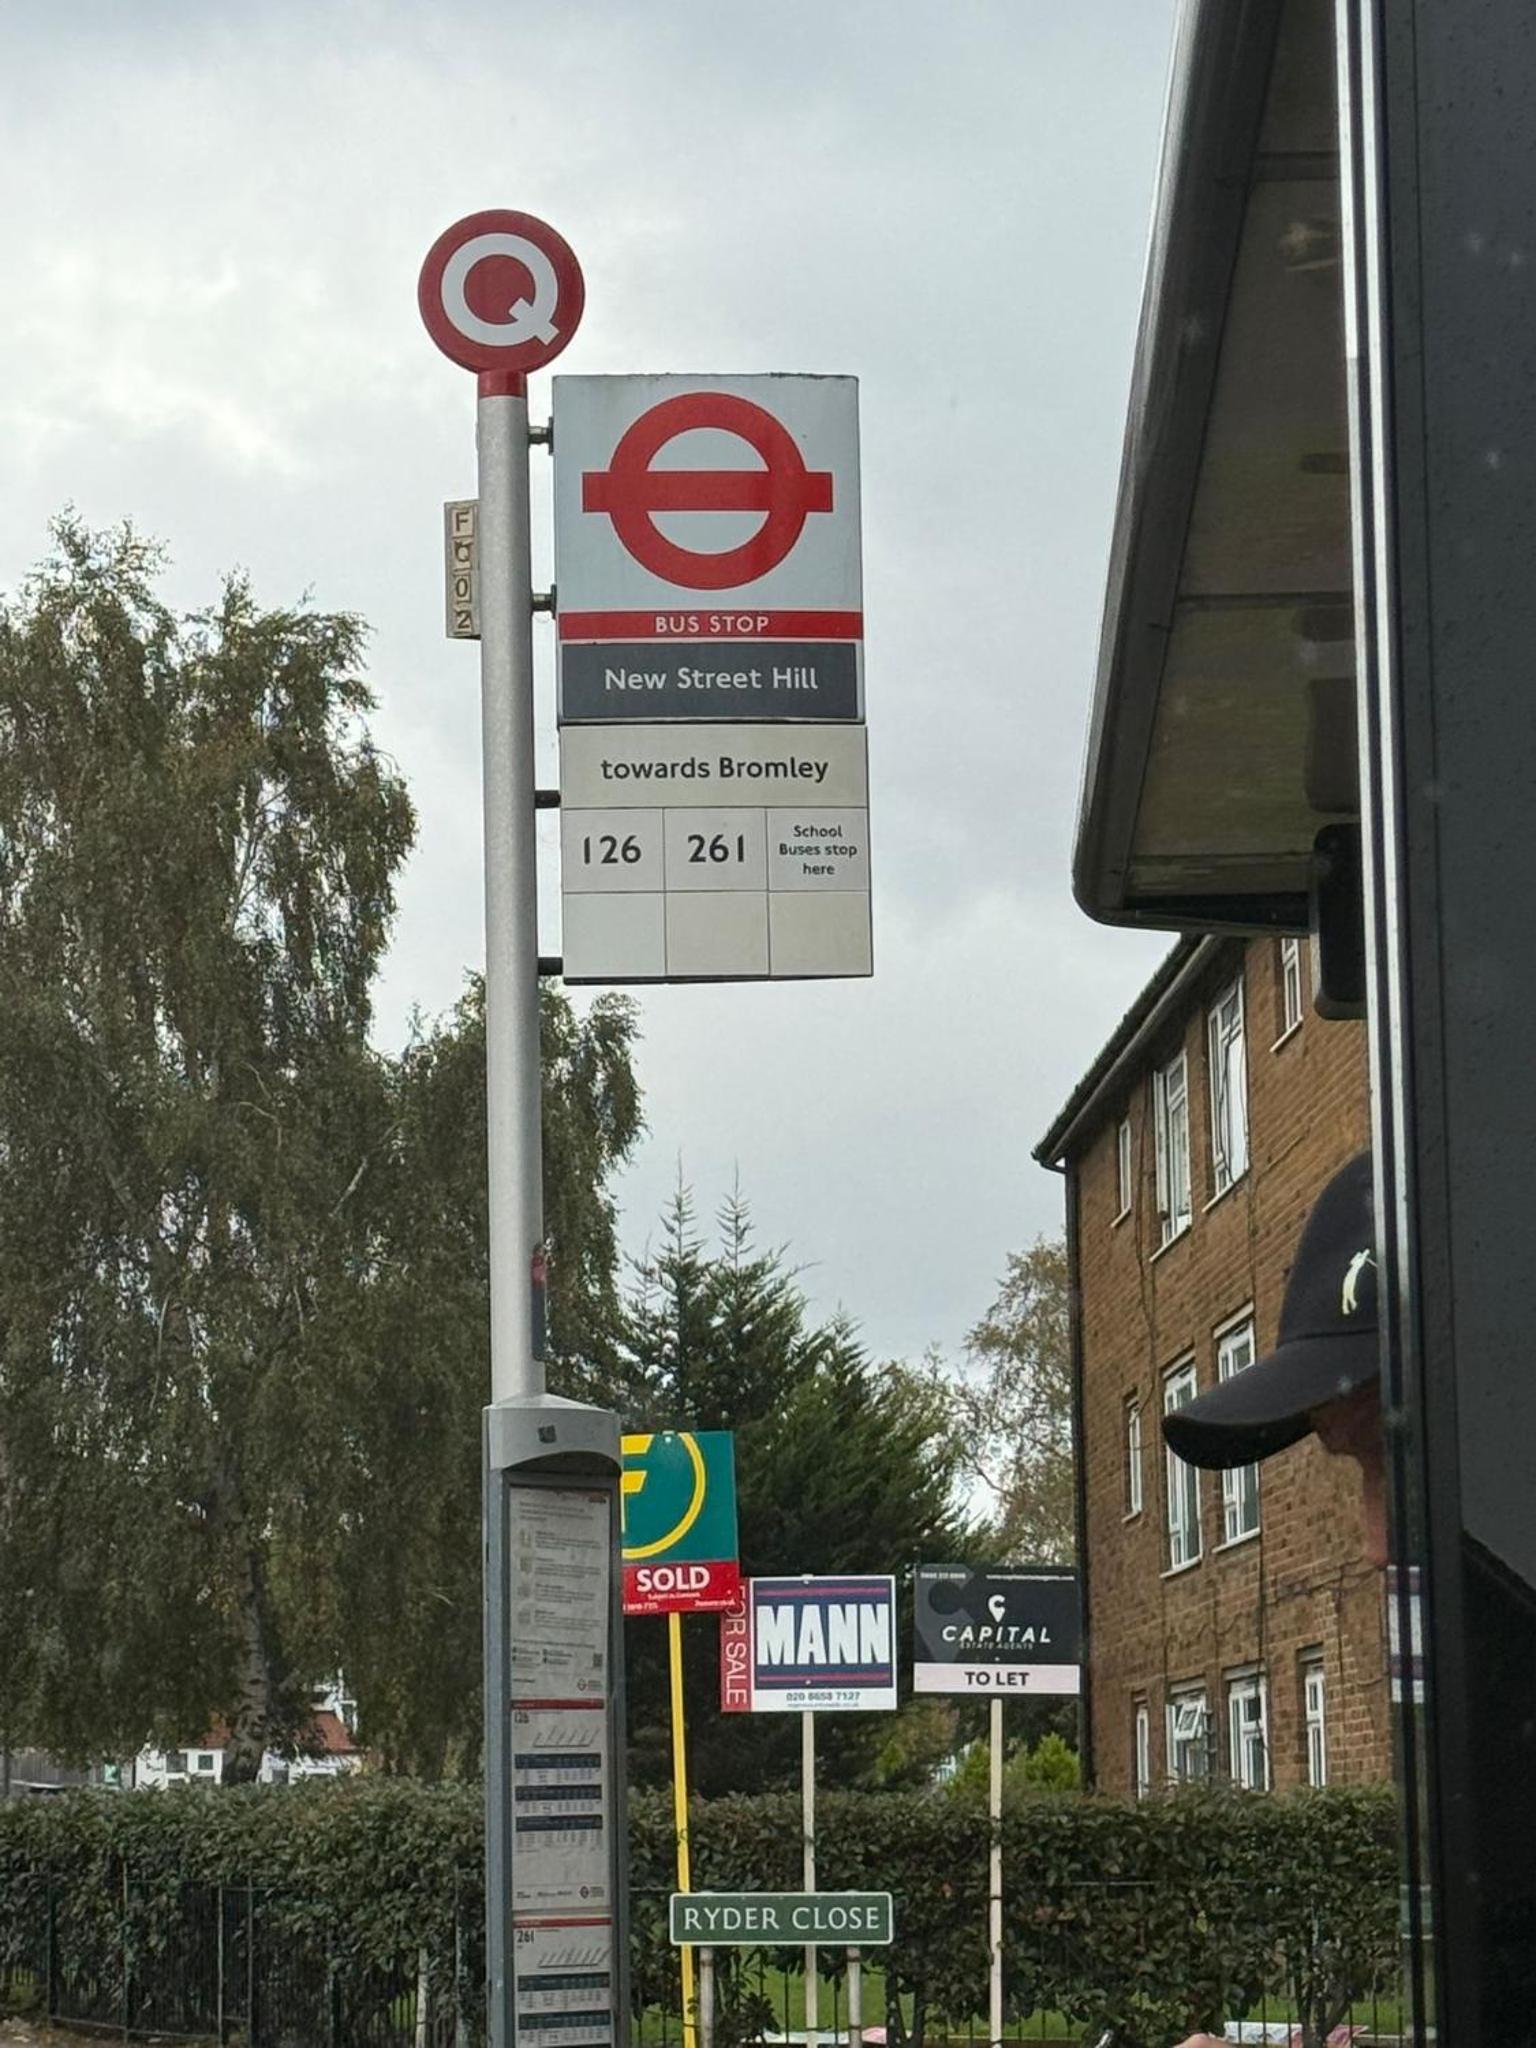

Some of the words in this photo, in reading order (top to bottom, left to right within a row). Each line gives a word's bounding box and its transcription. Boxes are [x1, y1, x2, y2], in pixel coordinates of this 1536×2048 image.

[441, 232, 560, 346] Q
[655, 616, 700, 634] BUS
[709, 616, 769, 633] STOP
[604, 668, 666, 691] New
[677, 667, 762, 690] Street
[773, 667, 818, 689] Hill
[601, 757, 711, 780] towards
[719, 756, 829, 783] Bromley
[793, 825, 843, 838] School
[583, 835, 642, 864] 126
[687, 834, 745, 863] 261
[779, 843, 821, 856] Buses
[825, 843, 858, 858] stop
[802, 862, 835, 875] here
[636, 1565, 711, 1592] SOLD
[756, 1603, 890, 1666] MANN
[942, 1625, 1051, 1643] CAPITAL
[726, 1642, 747, 1705] SALE
[964, 1671, 990, 1685] TO
[996, 1671, 1030, 1686] LET
[683, 1906, 780, 1930] RYDER
[792, 1906, 880, 1930] CLOSE
[516, 1930, 535, 1944] 261
